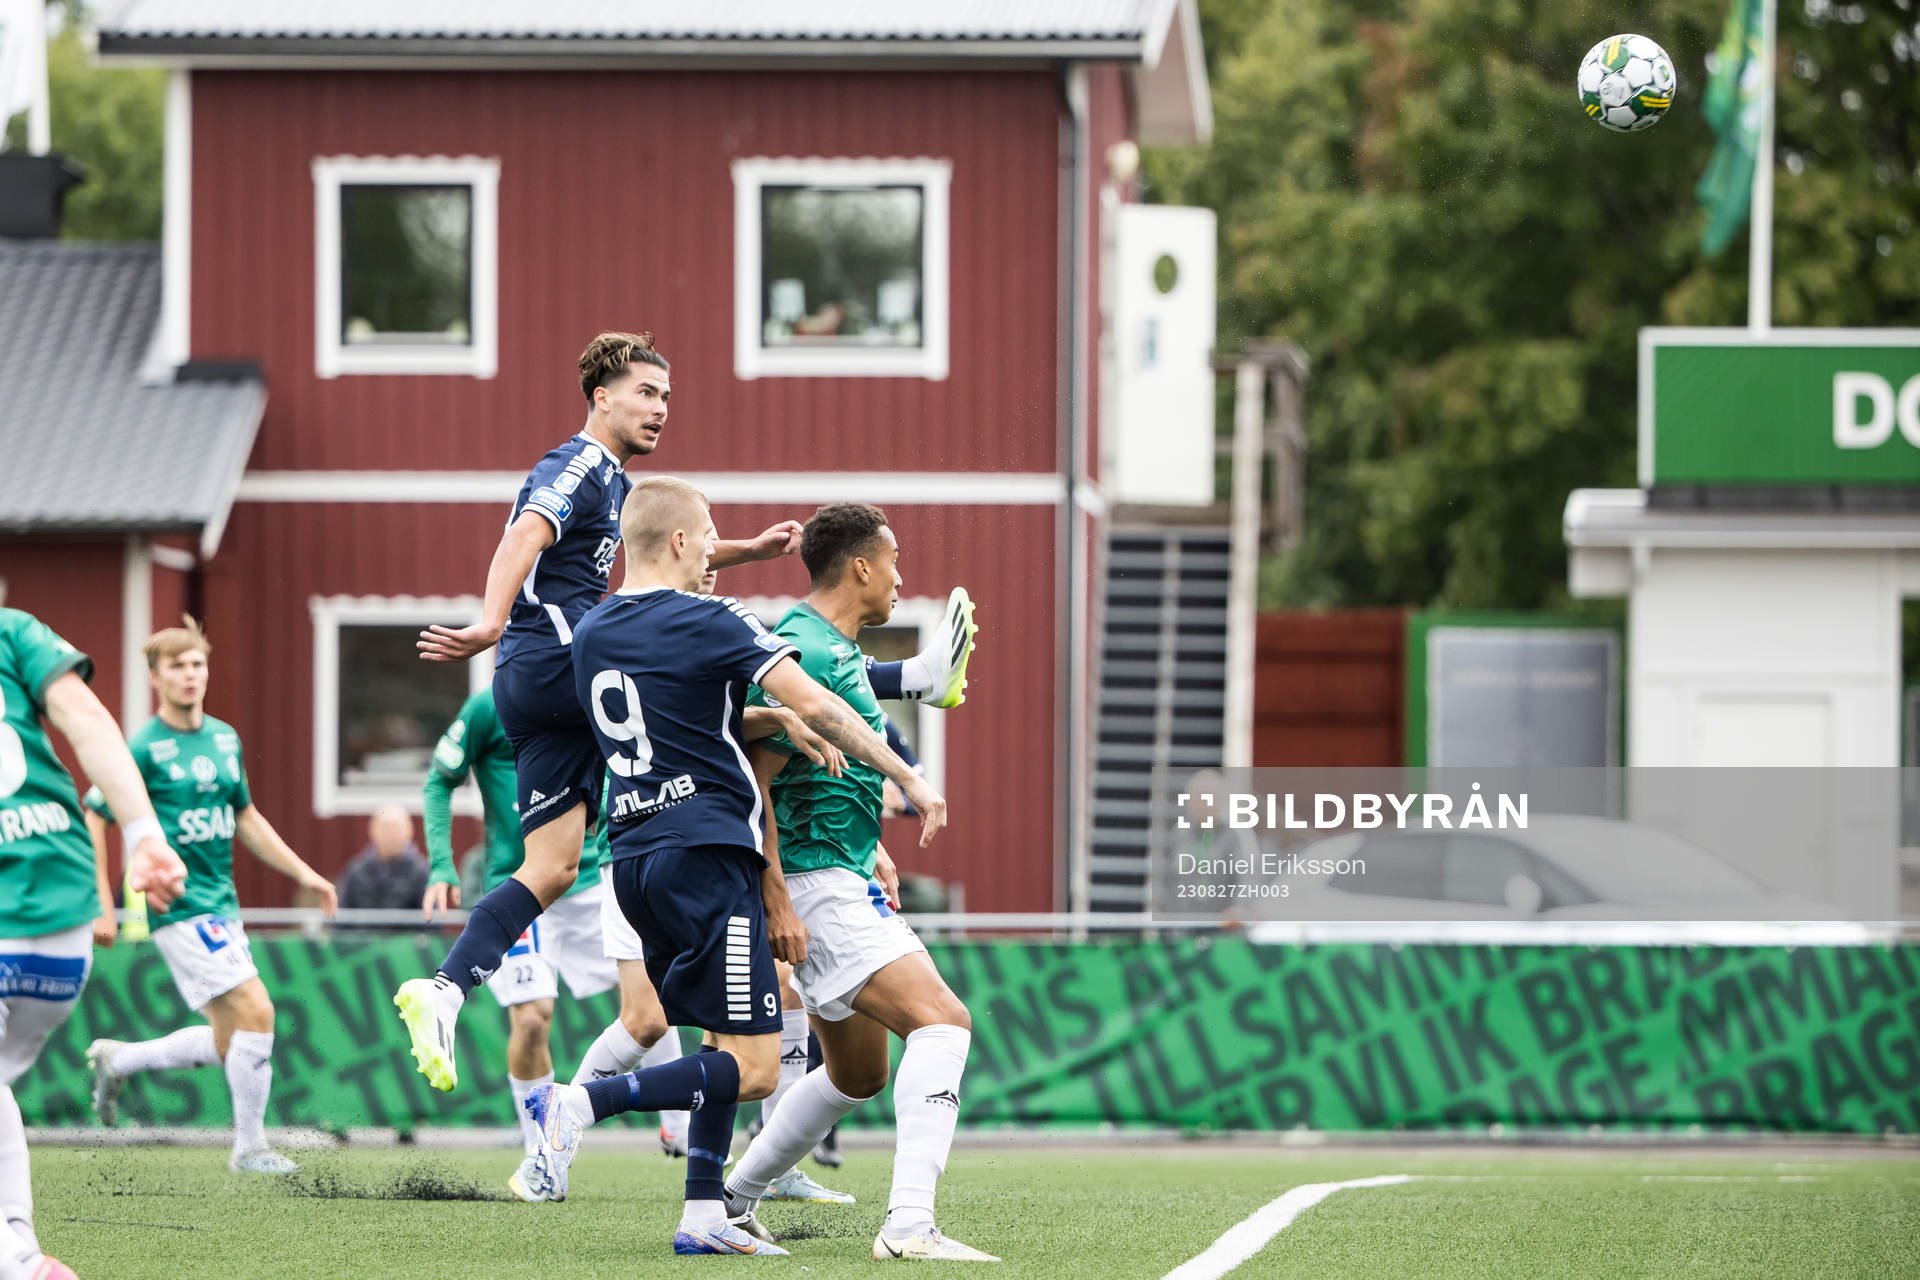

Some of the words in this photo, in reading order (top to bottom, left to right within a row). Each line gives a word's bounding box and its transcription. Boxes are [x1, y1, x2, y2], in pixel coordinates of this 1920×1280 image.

[591, 669, 653, 777] 9
[0, 800, 71, 845] RAND
[514, 966, 535, 985] 22
[763, 992, 778, 1018] 9
[1419, 990, 1518, 1096] IK
